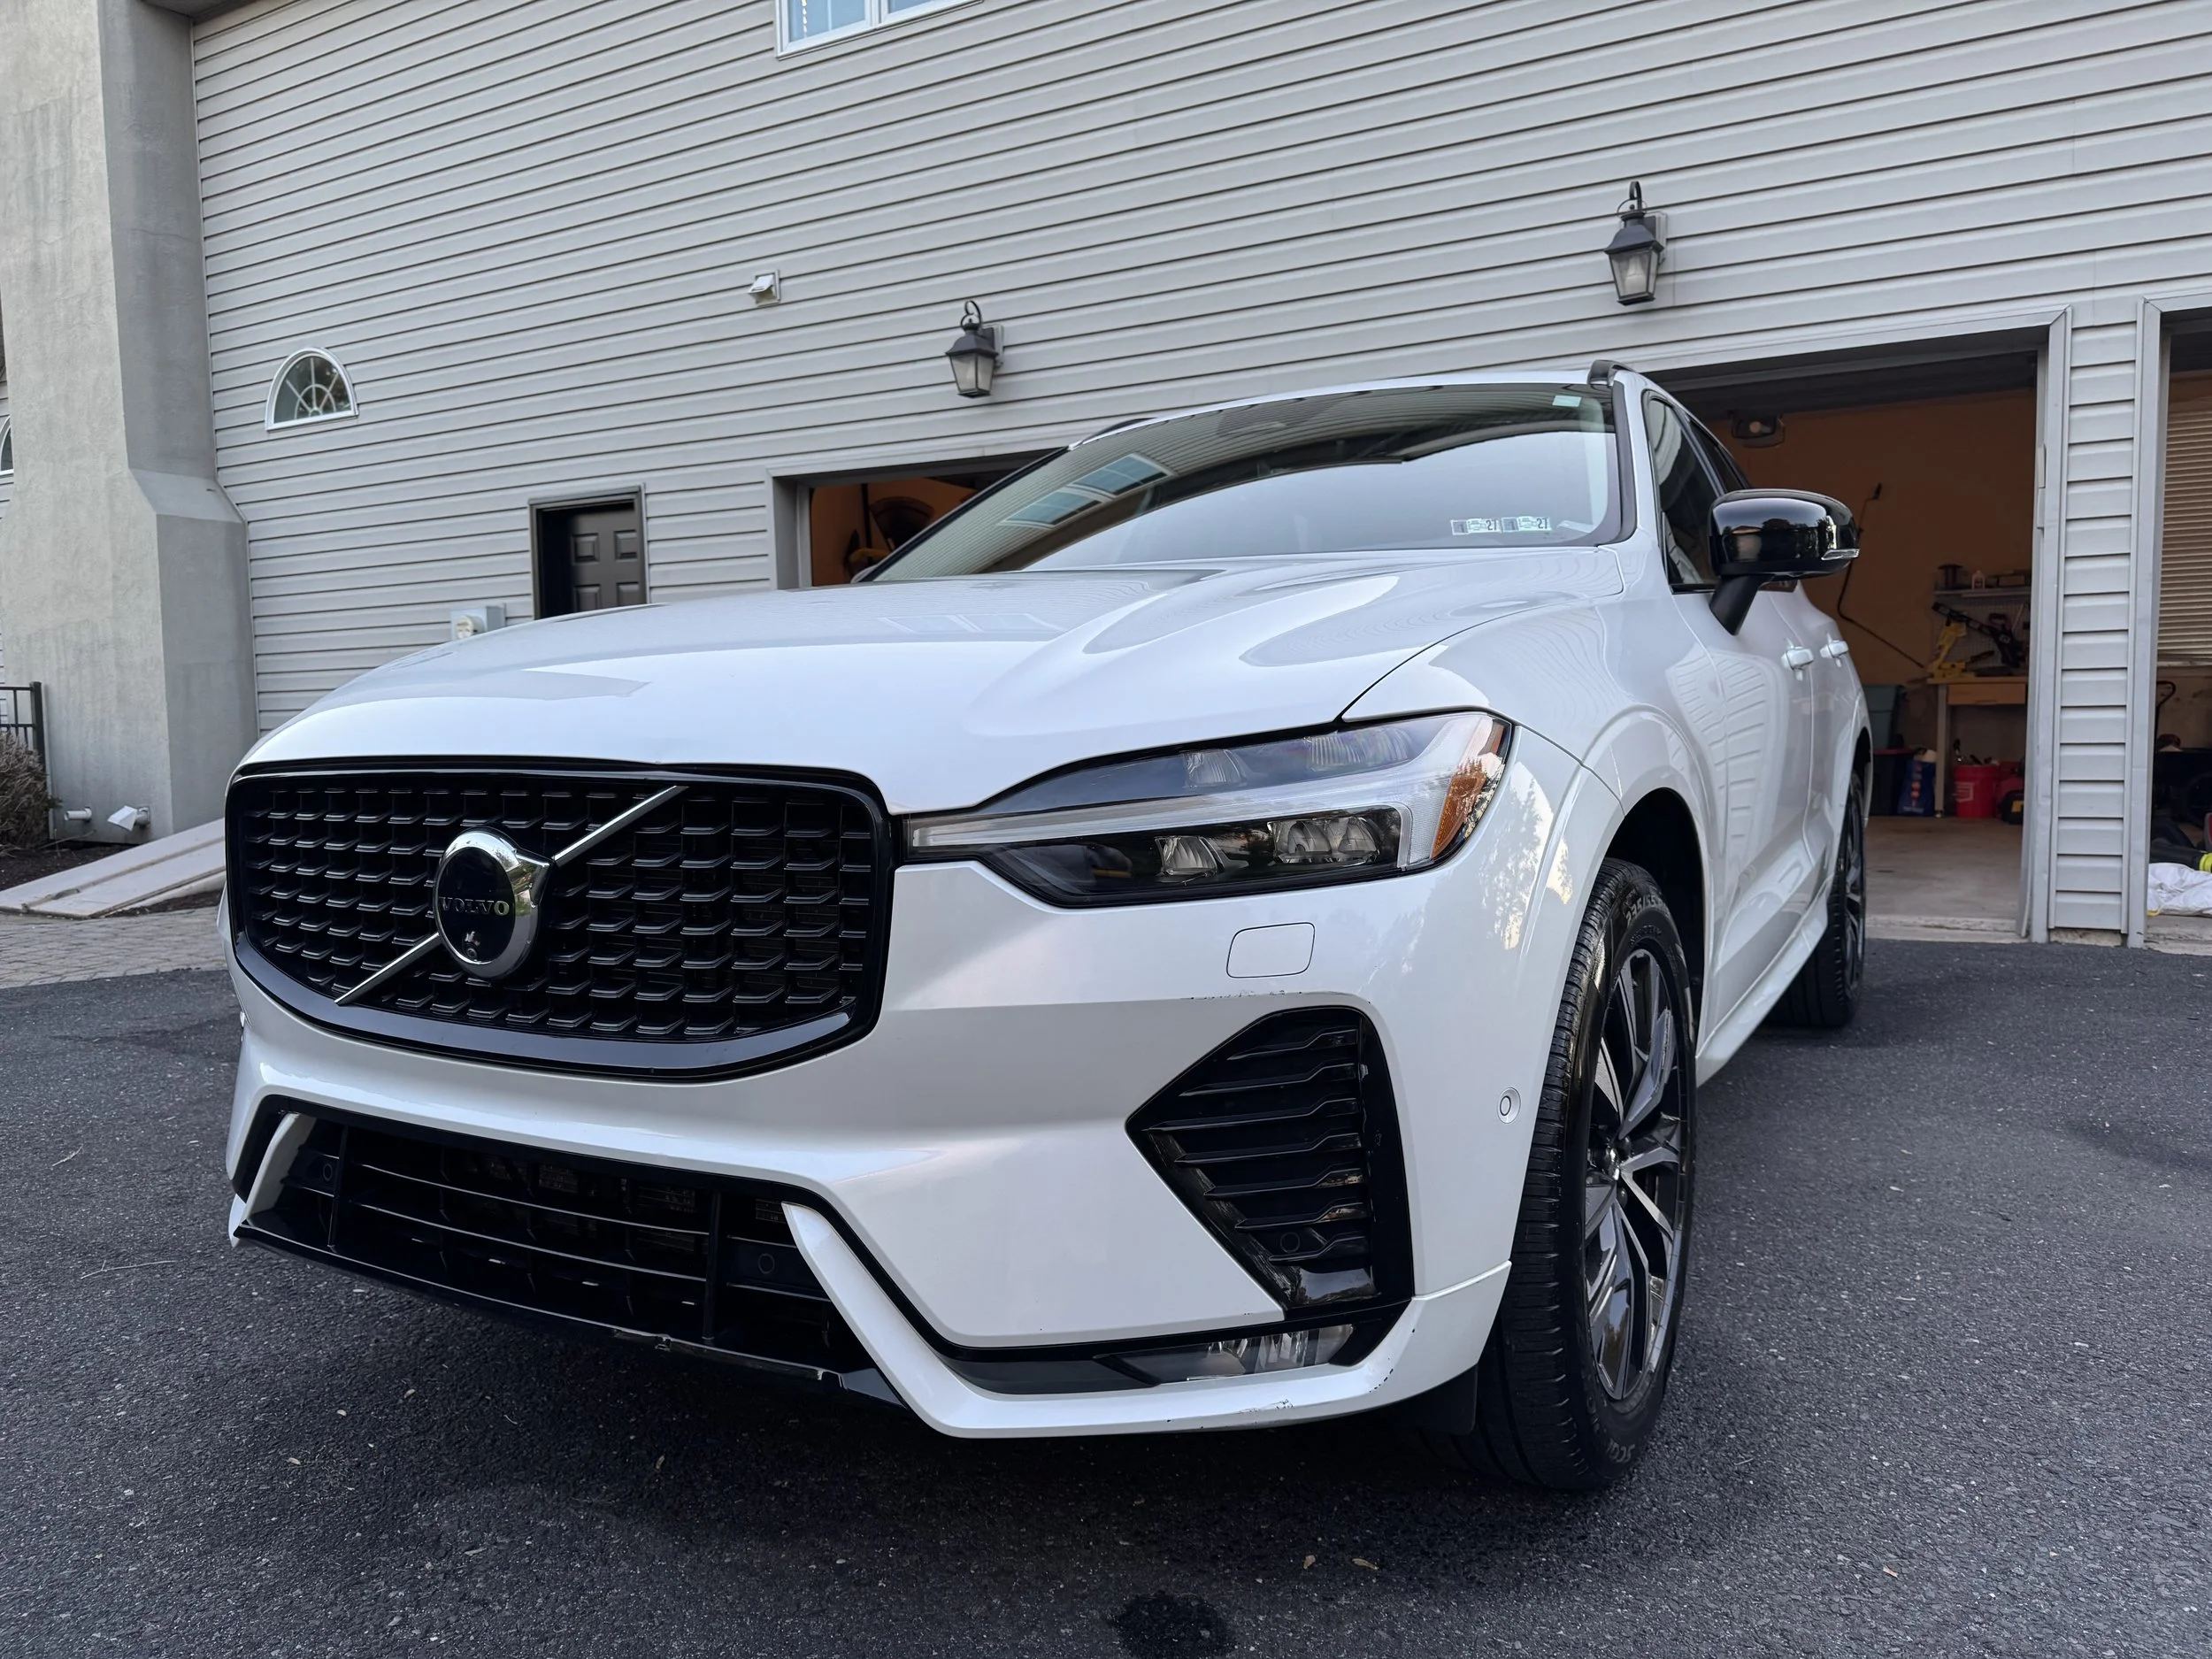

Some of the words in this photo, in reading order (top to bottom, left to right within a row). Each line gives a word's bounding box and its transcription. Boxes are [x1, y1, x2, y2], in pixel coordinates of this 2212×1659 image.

[1486, 519, 1497, 531] 27
[1536, 517, 1548, 529] 27
[439, 896, 511, 917] VOLVO
